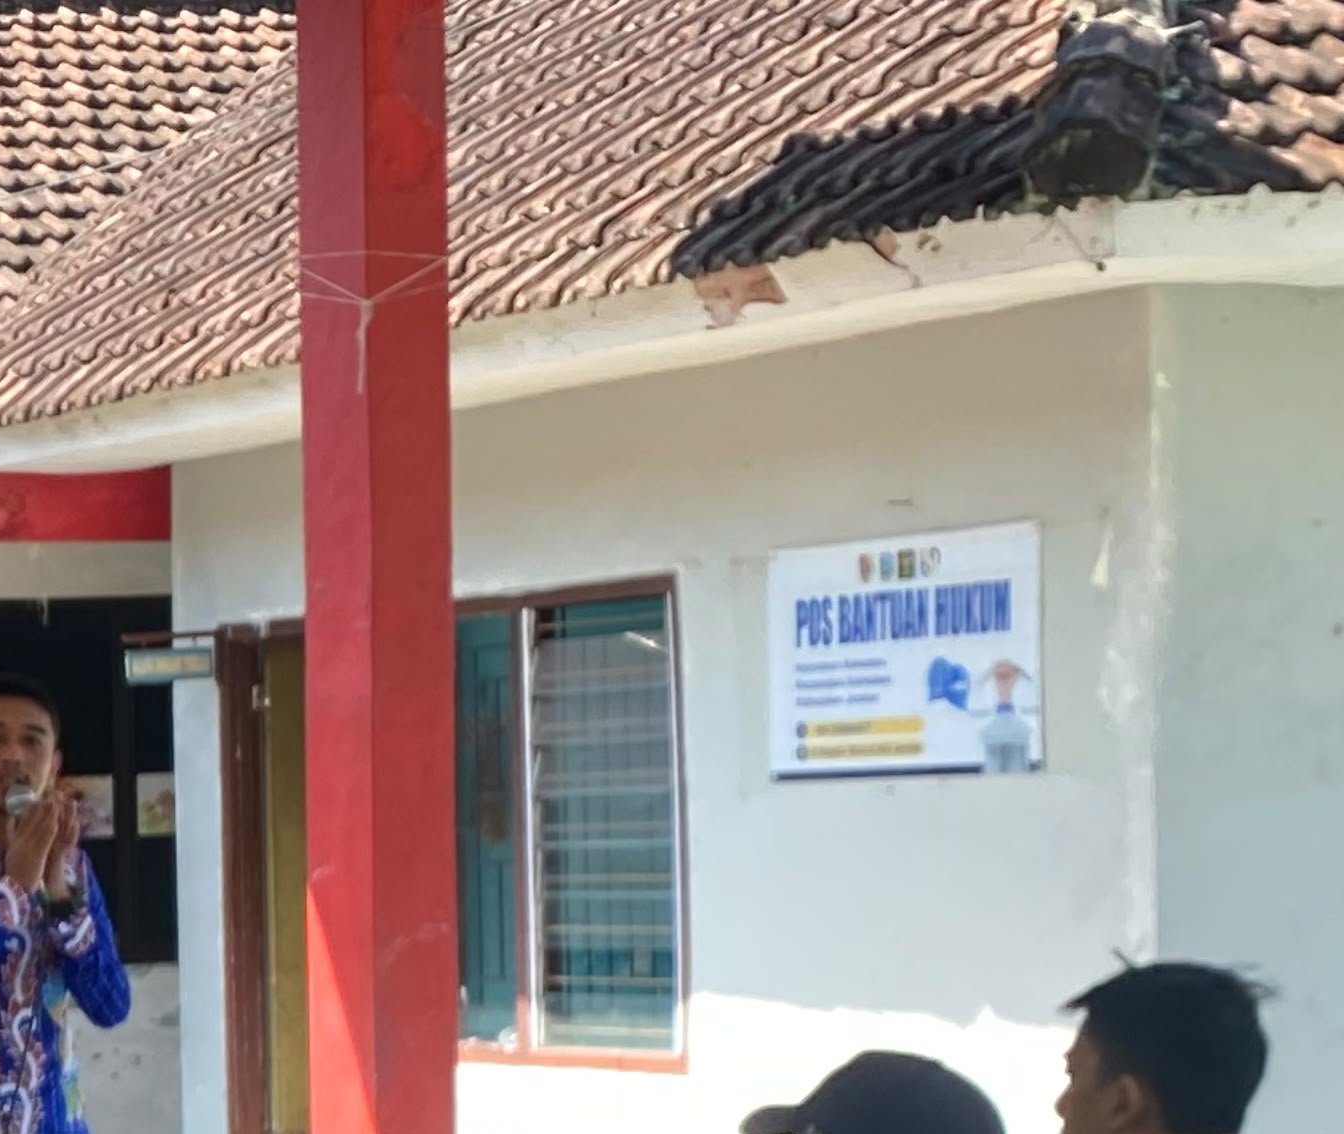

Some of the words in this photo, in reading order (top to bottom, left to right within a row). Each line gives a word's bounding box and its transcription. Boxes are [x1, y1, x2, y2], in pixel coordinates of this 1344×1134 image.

[795, 596, 834, 648] POS
[838, 587, 929, 645] BANTUAN
[934, 578, 1012, 638] HUKUM
